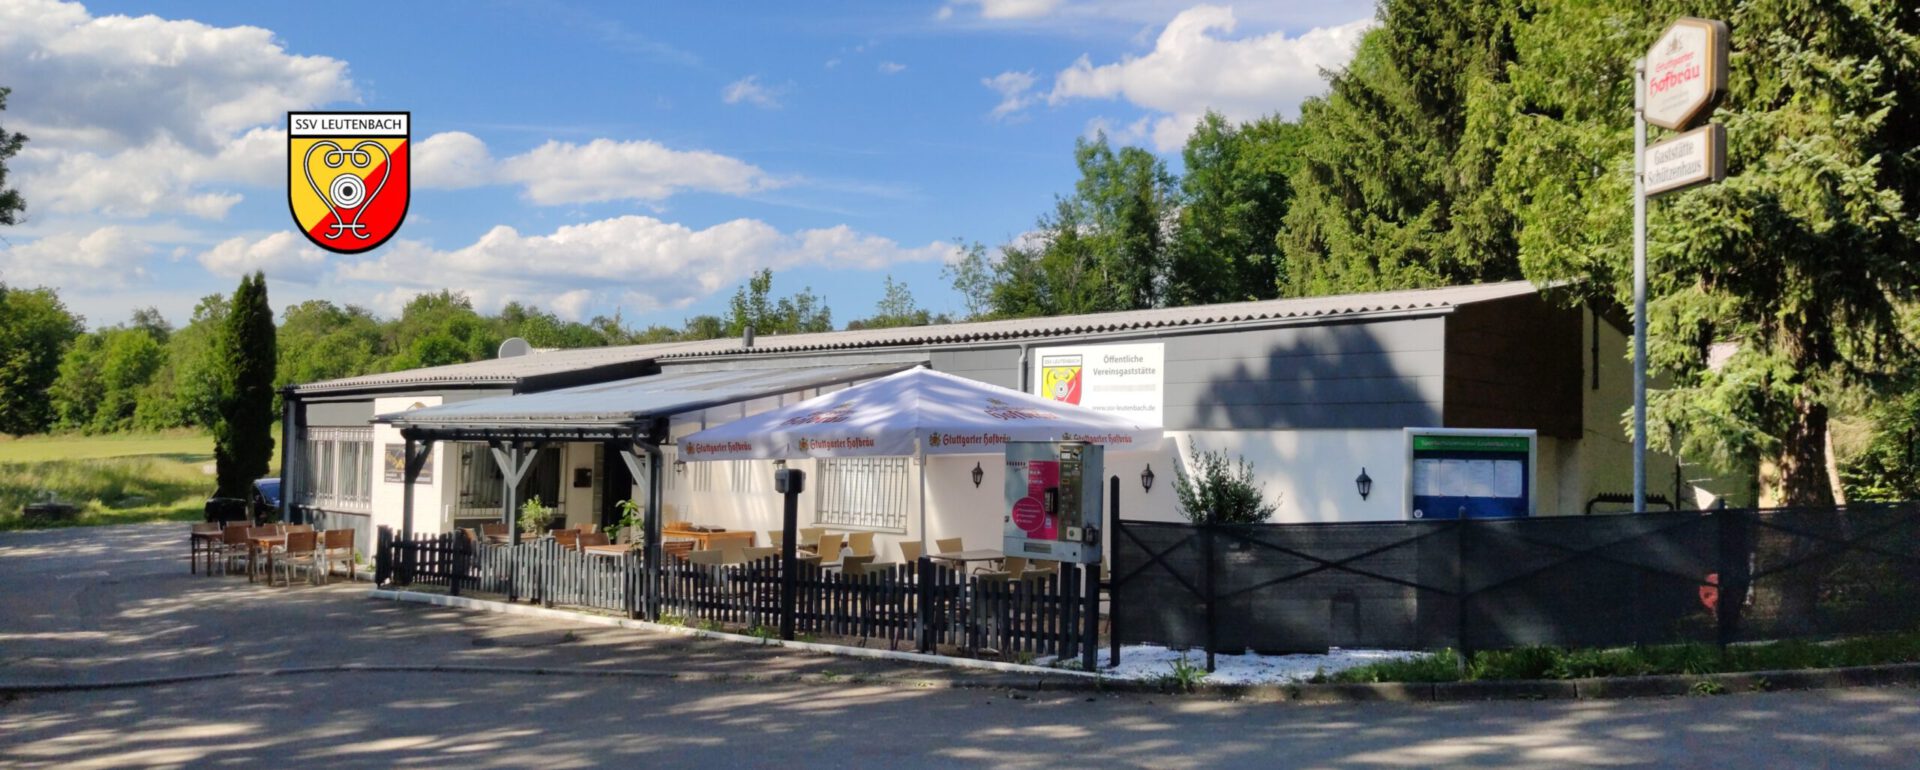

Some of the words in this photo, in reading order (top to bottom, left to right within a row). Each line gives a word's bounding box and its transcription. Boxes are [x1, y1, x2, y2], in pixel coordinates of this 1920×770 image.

[1103, 354, 1144, 364] Öffentliche
[1092, 366, 1156, 377] Vereinsgaststätte
[810, 439, 845, 450] Stuttgarter
[846, 437, 874, 449] Hofbräu
[943, 434, 982, 447] Stuttgarter
[696, 443, 727, 454] Stuttgarter
[728, 441, 752, 453] Hofbräu
